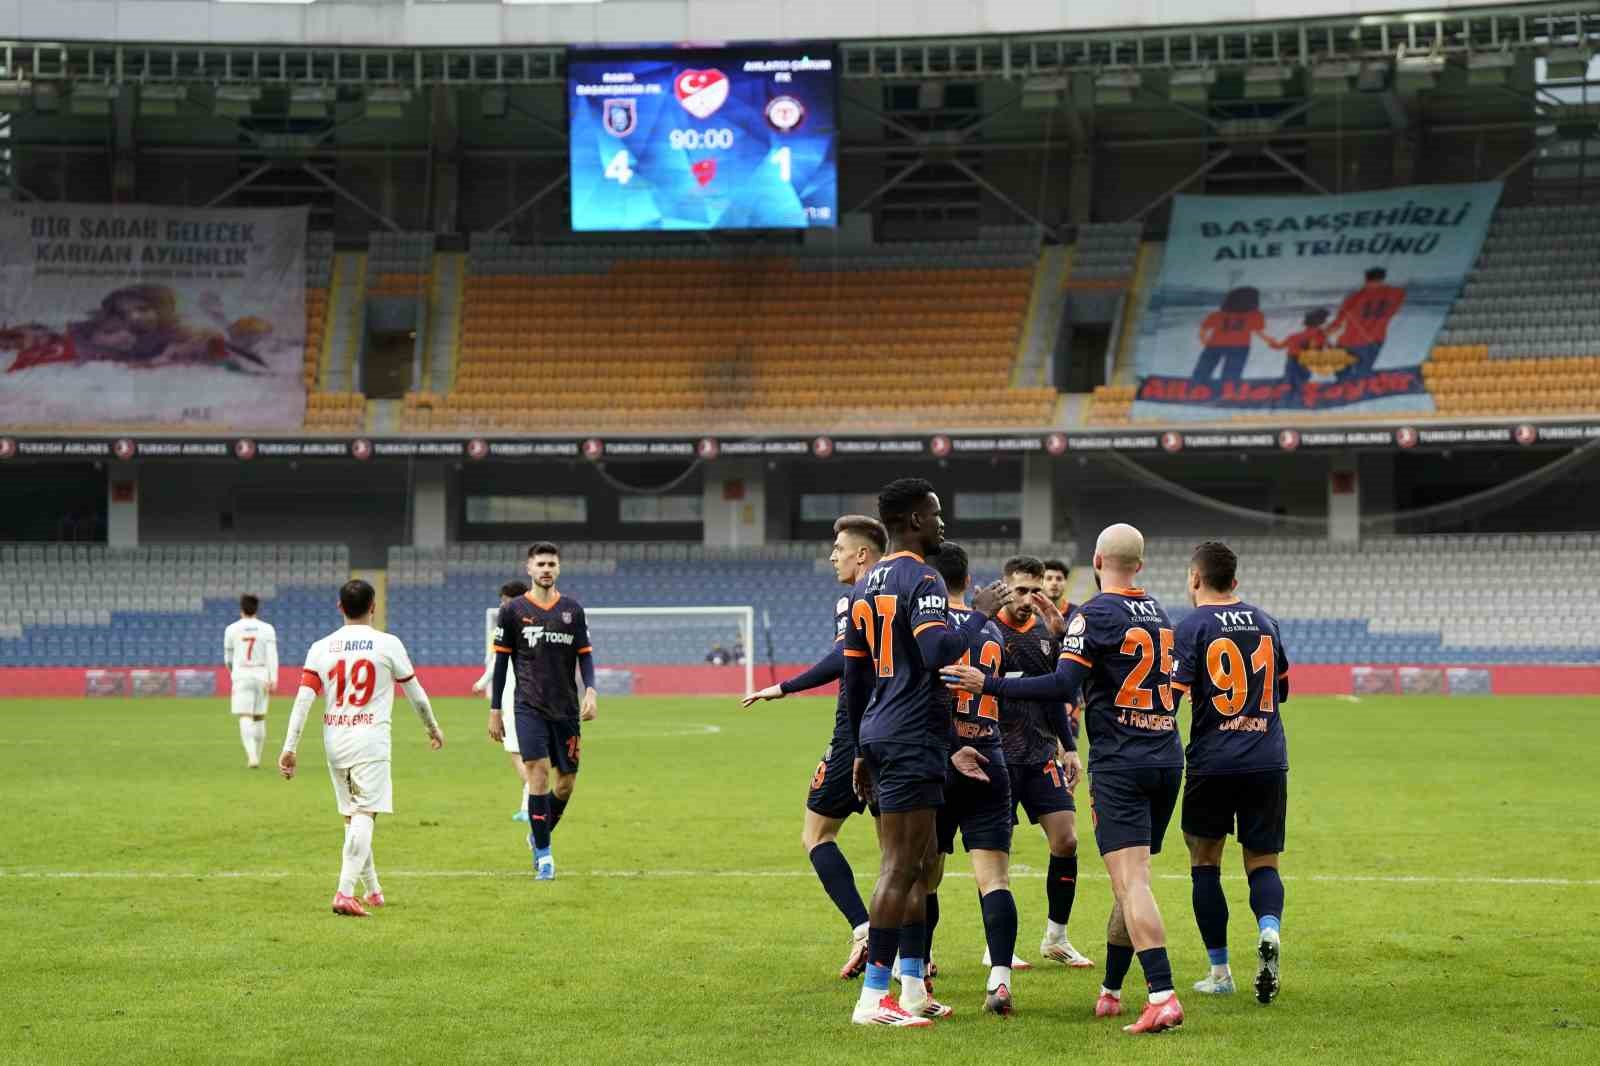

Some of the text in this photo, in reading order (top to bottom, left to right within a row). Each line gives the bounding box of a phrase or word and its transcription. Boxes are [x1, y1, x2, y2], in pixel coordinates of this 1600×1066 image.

[670, 128, 733, 150] 90:00
[604, 149, 634, 185] 4
[771, 147, 792, 182] 1
[166, 218, 256, 243] GELECEK
[1200, 200, 1472, 239] BAŞAKŞEHİRLİ
[1213, 232, 1441, 261] AİLE TRİBÜNÜ
[918, 595, 946, 610] HDI
[1123, 600, 1158, 616] YKT
[1214, 611, 1253, 625] YKT
[242, 636, 257, 661] 7
[344, 640, 374, 652] ARCA
[852, 594, 898, 678] 27
[327, 658, 377, 708] 19
[1114, 627, 1175, 711] 25
[1206, 635, 1275, 717] 91
